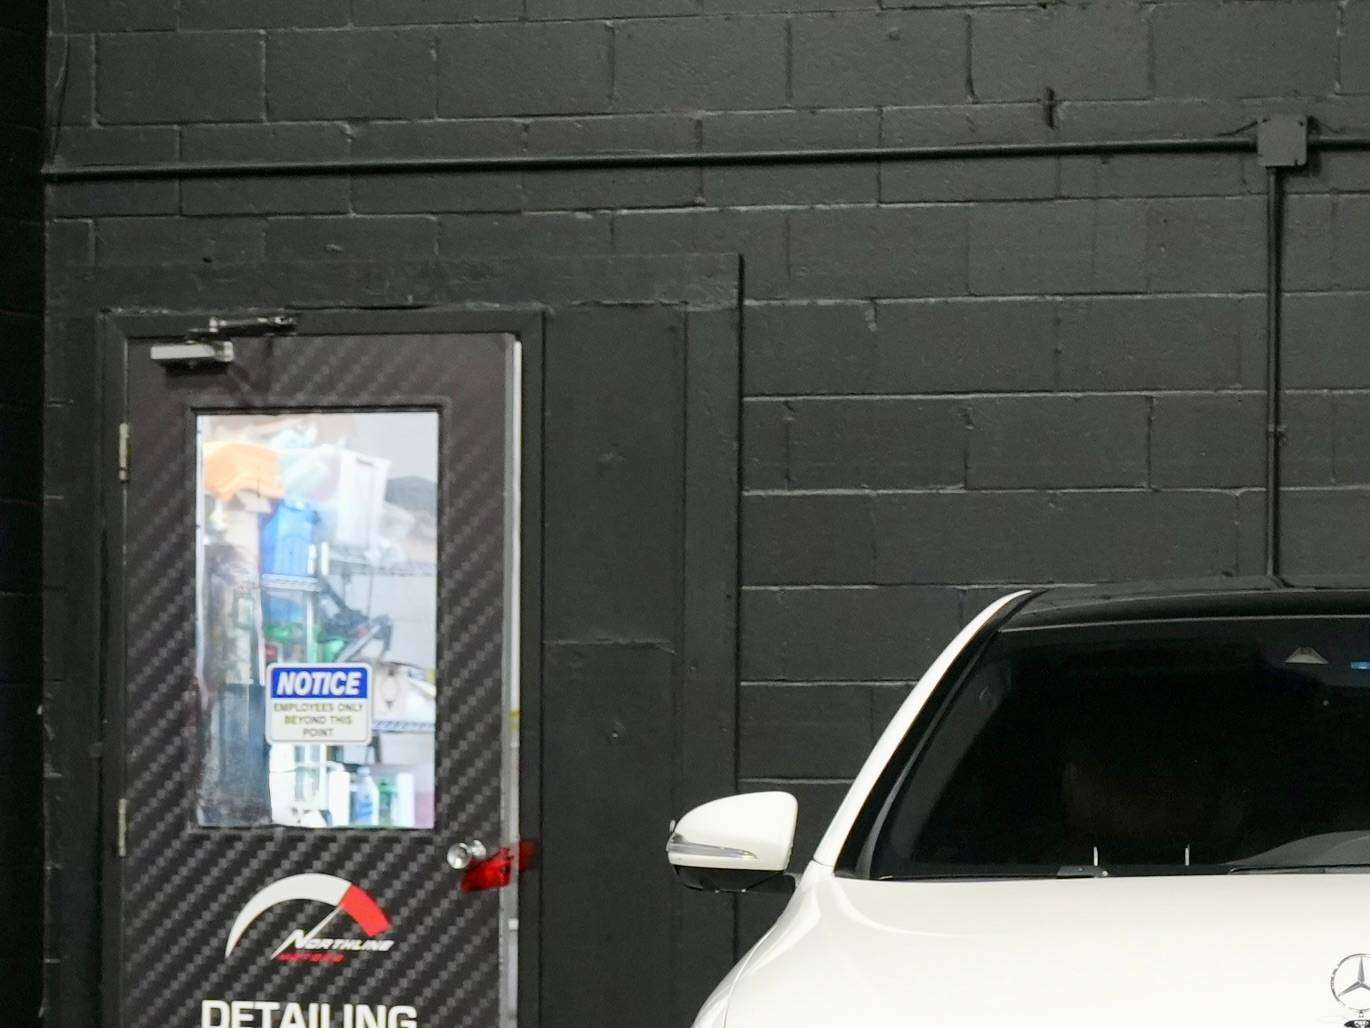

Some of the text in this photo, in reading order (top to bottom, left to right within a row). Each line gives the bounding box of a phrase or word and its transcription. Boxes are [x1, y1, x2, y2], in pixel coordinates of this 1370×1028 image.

[276, 671, 362, 696] NOTICE
[274, 703, 363, 712] EMPLOYEES ONLY
[284, 715, 353, 725] BEYOND THIS
[302, 728, 334, 736] POINT
